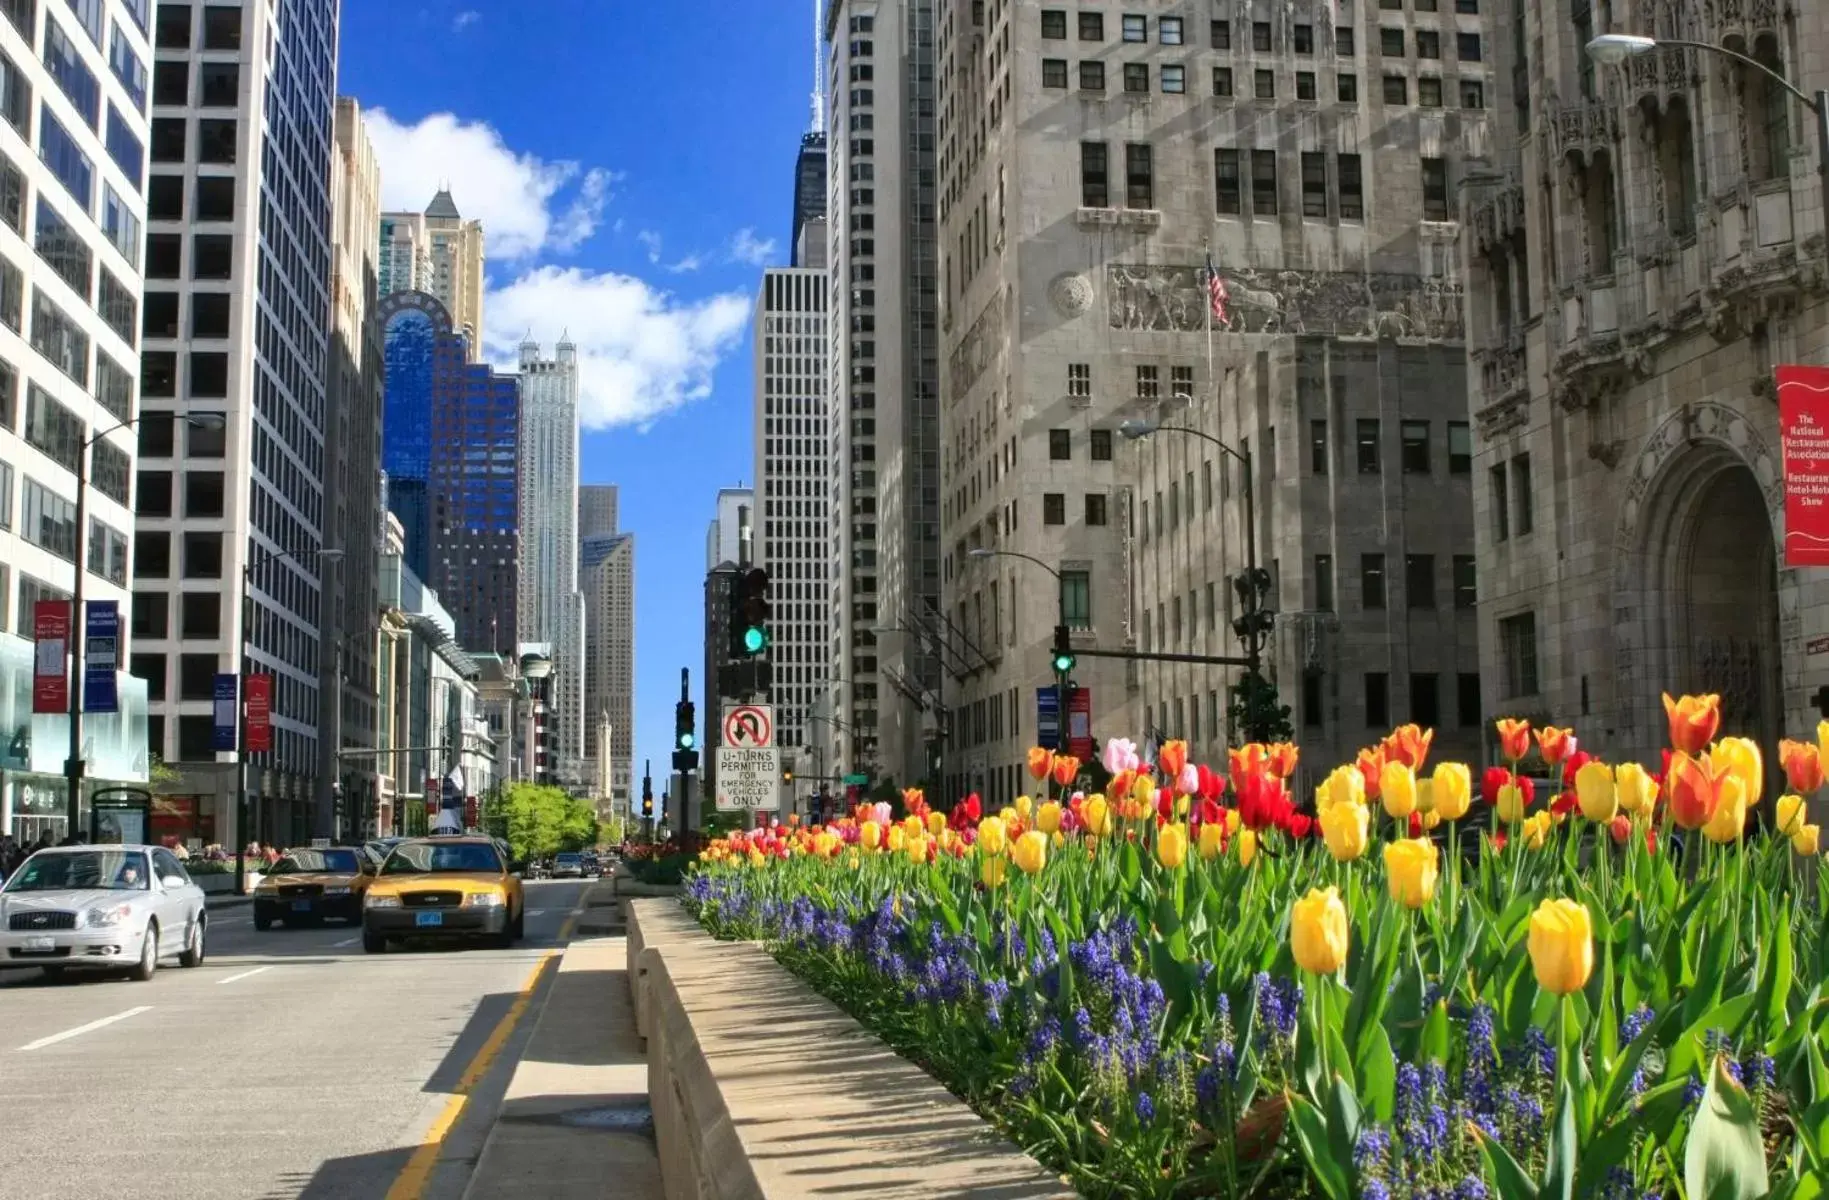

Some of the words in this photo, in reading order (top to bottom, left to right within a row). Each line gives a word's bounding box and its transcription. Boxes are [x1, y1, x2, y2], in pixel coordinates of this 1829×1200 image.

[1798, 414, 1814, 424] The
[1790, 425, 1824, 436] National
[1788, 472, 1829, 483] Restauran
[1801, 497, 1823, 506] Show
[723, 751, 773, 761] U-TURNS
[721, 761, 775, 772] PERMITTED
[739, 771, 756, 780] FOR
[721, 780, 773, 788] EMERGENCY
[727, 787, 769, 796] VEHICLES
[732, 796, 762, 806] ONLY
